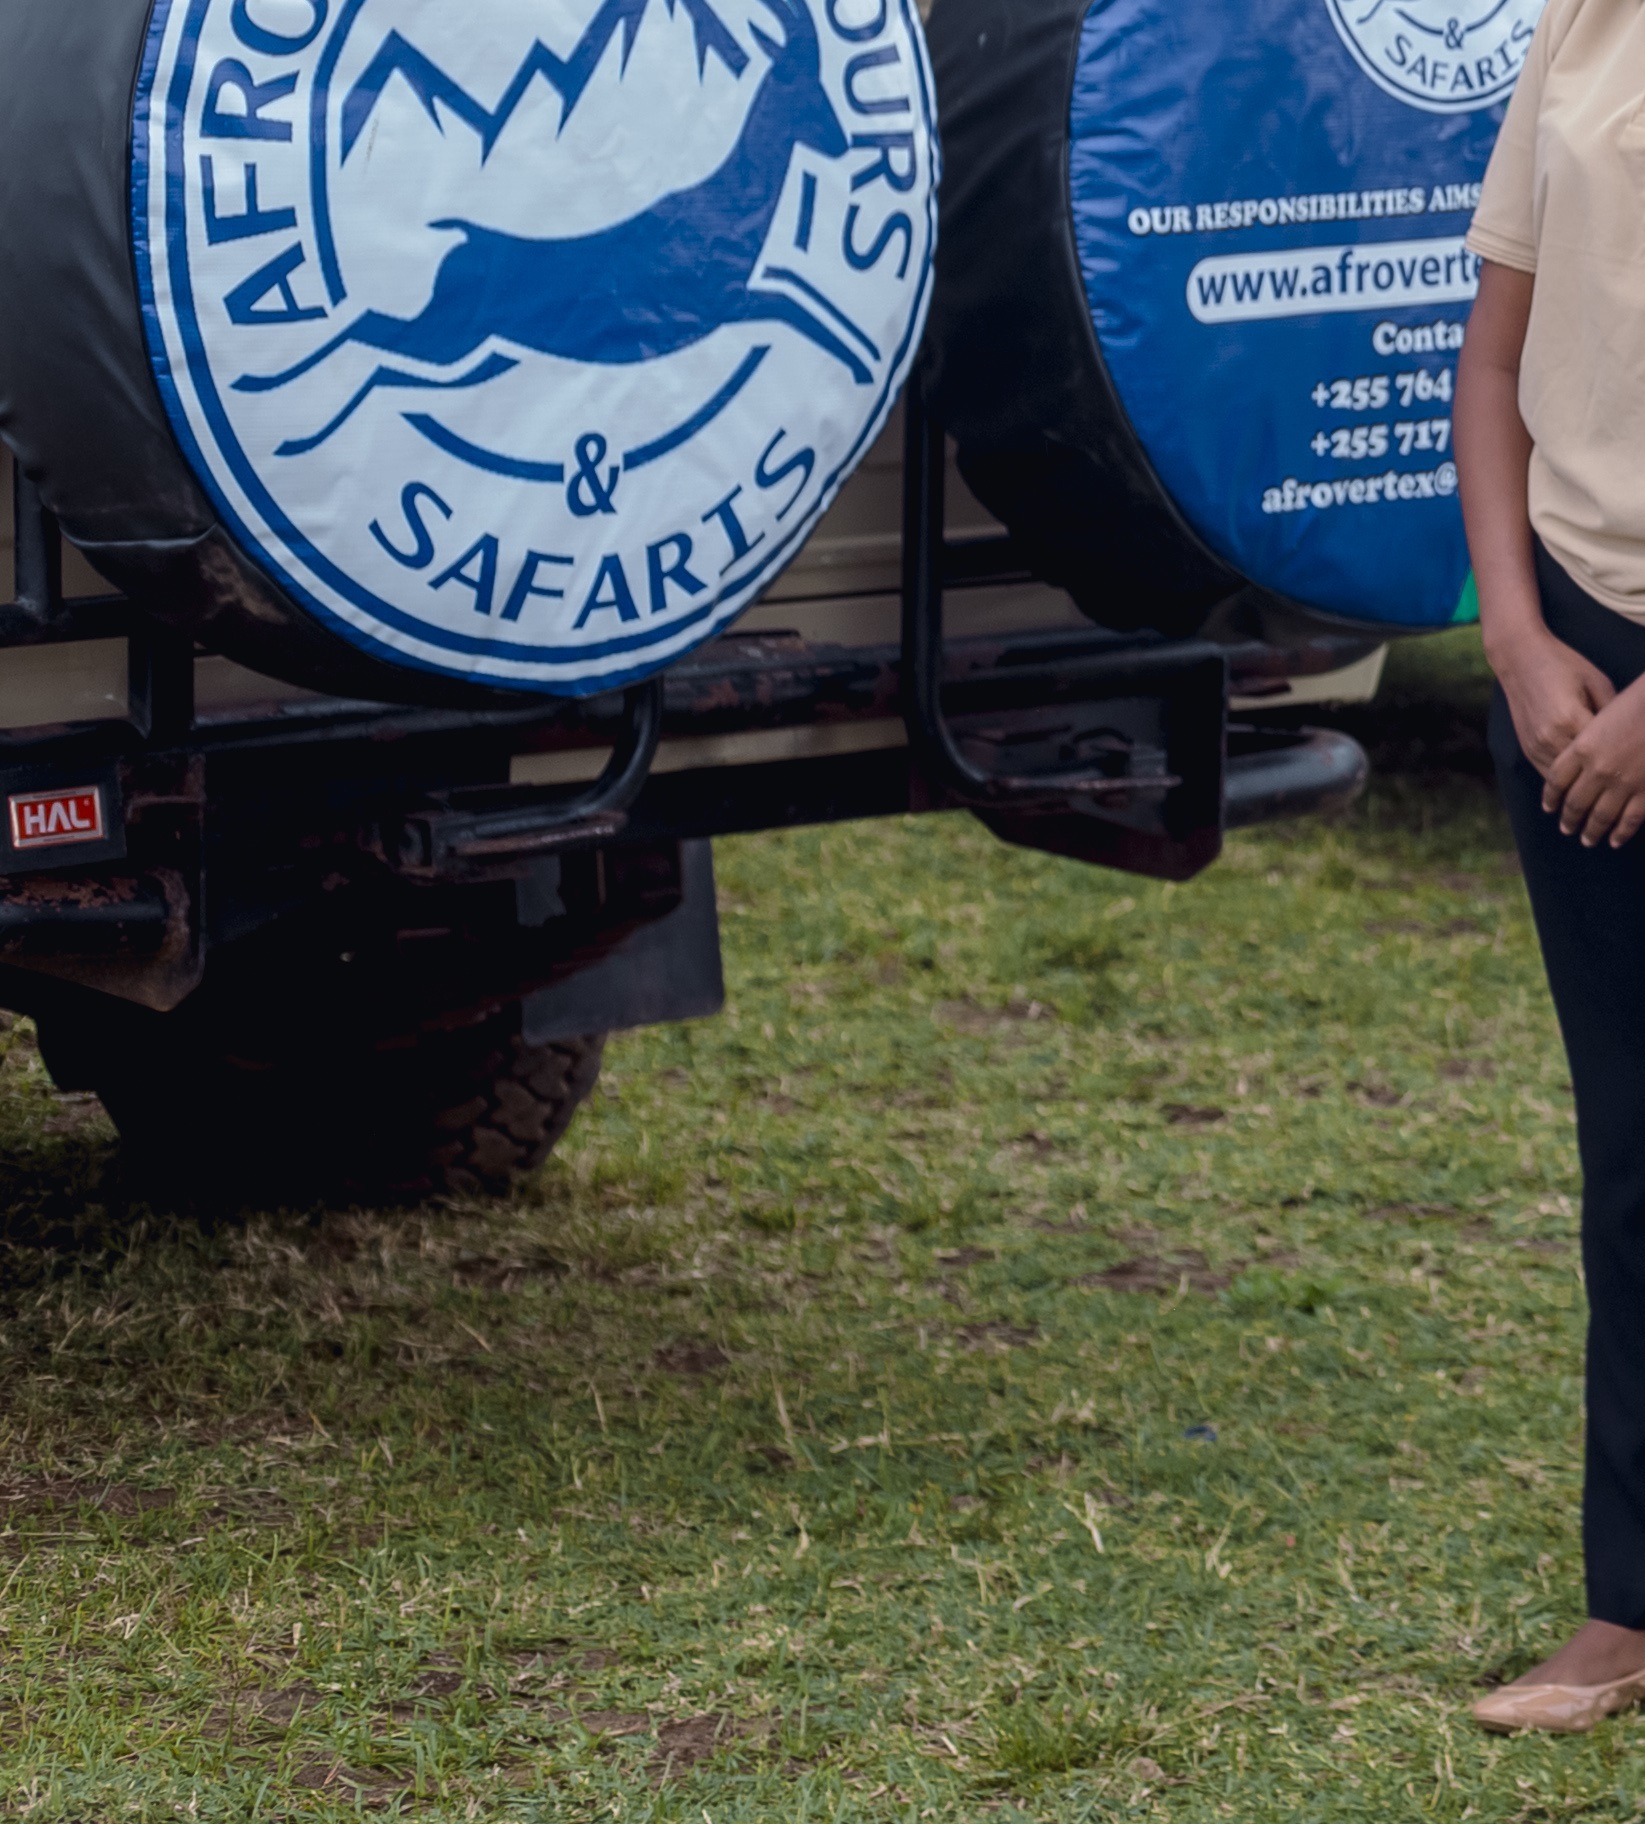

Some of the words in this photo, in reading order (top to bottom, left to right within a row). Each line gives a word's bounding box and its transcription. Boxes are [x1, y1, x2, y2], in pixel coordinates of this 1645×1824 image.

[1384, 18, 1536, 94] SAFARIS
[1444, 17, 1466, 51] &
[1128, 205, 1192, 236] OUR
[1195, 186, 1426, 232] RESPONSIBILITIES
[1428, 181, 1482, 213] AIMS
[1311, 375, 1390, 412] +255
[1395, 368, 1453, 408] 764
[1310, 424, 1389, 460] +255
[1394, 418, 1451, 456] 717
[563, 431, 621, 517] &
[368, 426, 819, 630] SAFARIS
[23, 799, 91, 836] HAL
